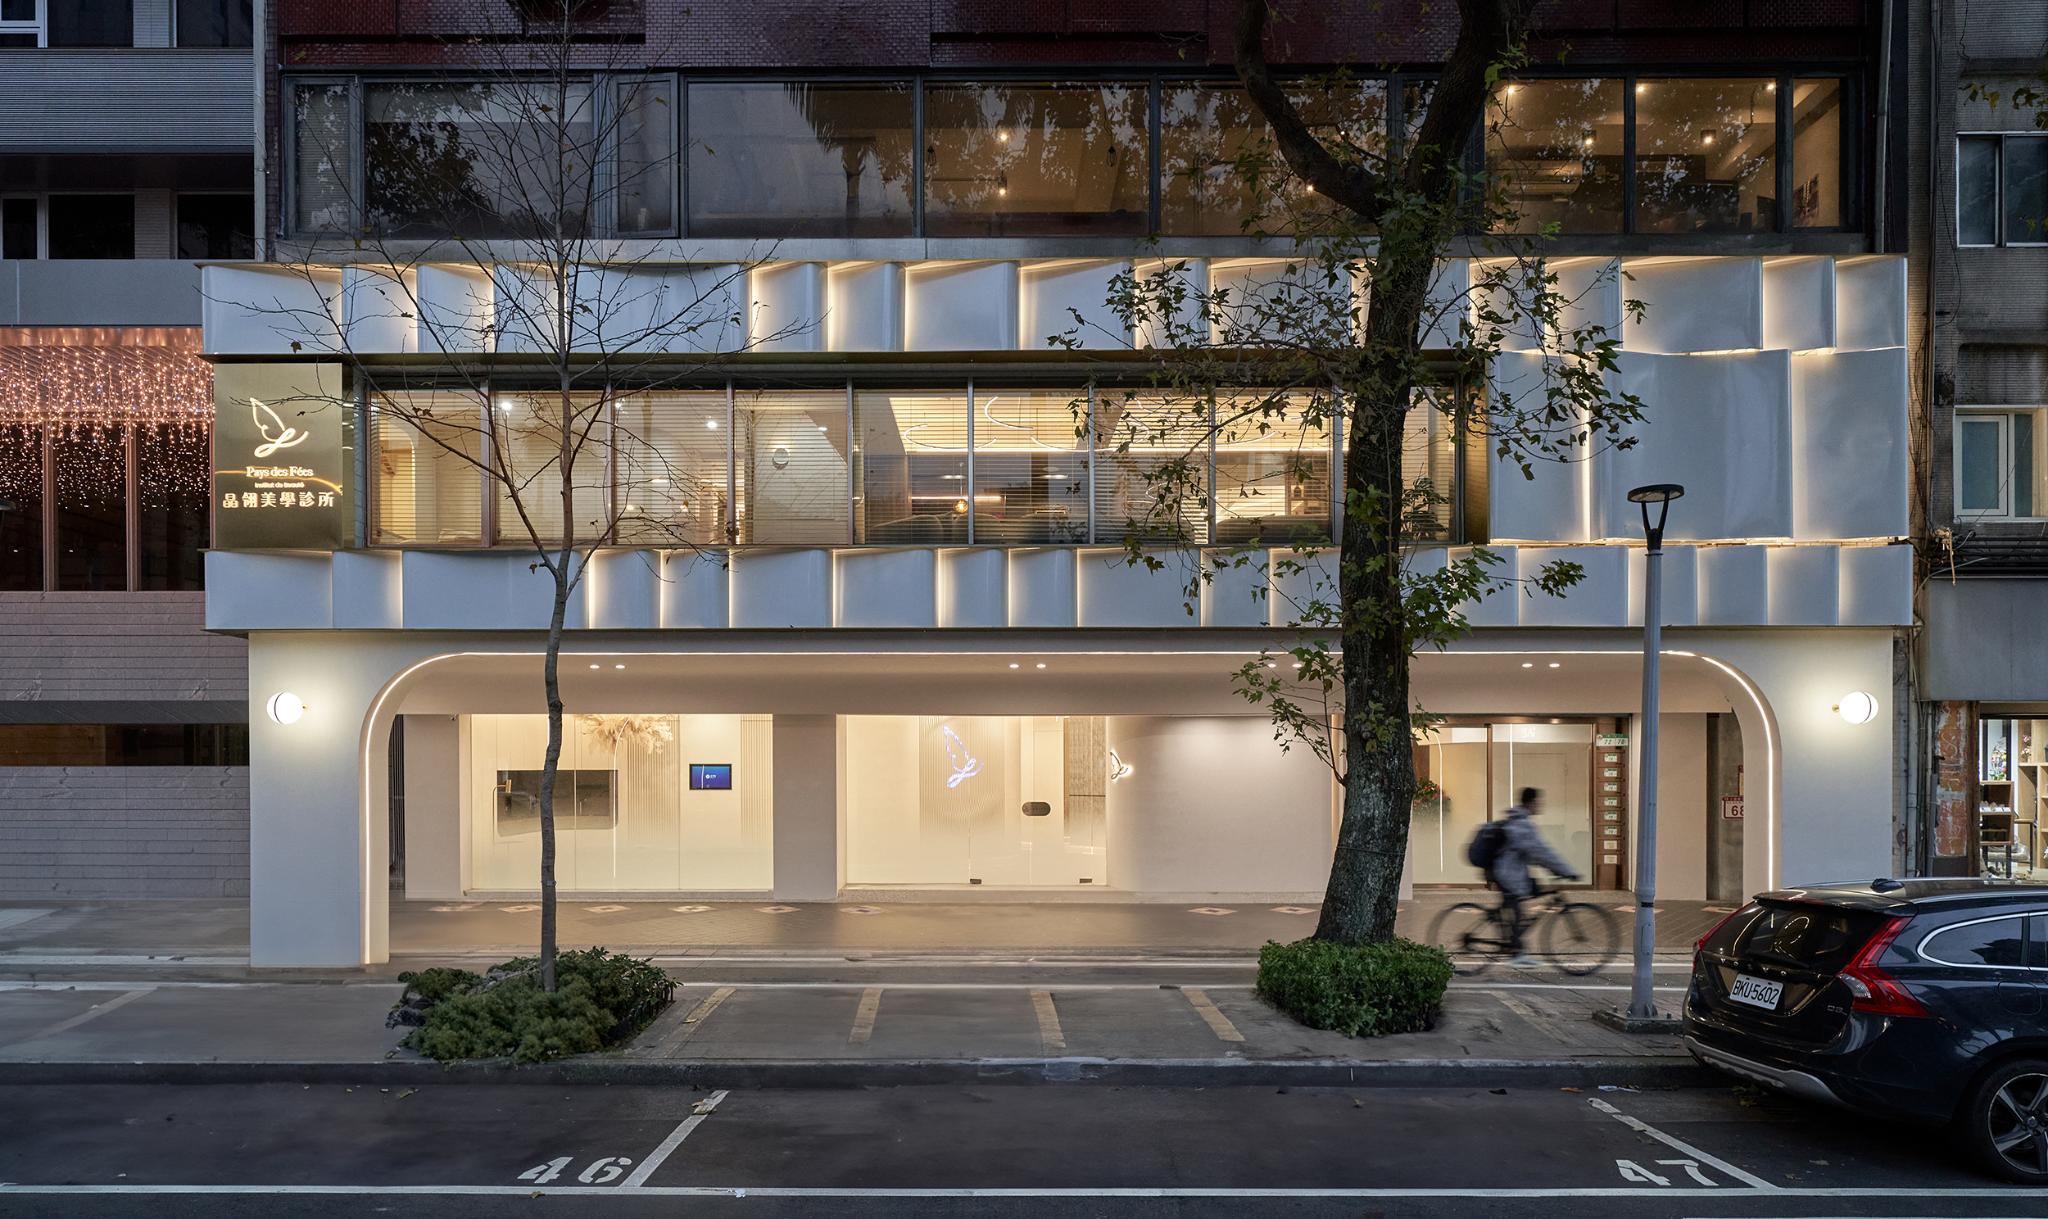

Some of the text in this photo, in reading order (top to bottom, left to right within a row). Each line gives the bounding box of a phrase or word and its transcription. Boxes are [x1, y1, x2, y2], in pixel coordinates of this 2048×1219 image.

[246, 466, 314, 479] Pays des Fées
[1732, 980, 1781, 1005] BKU-5602
[517, 1156, 632, 1184] 46
[1615, 1159, 1719, 1186] 47
